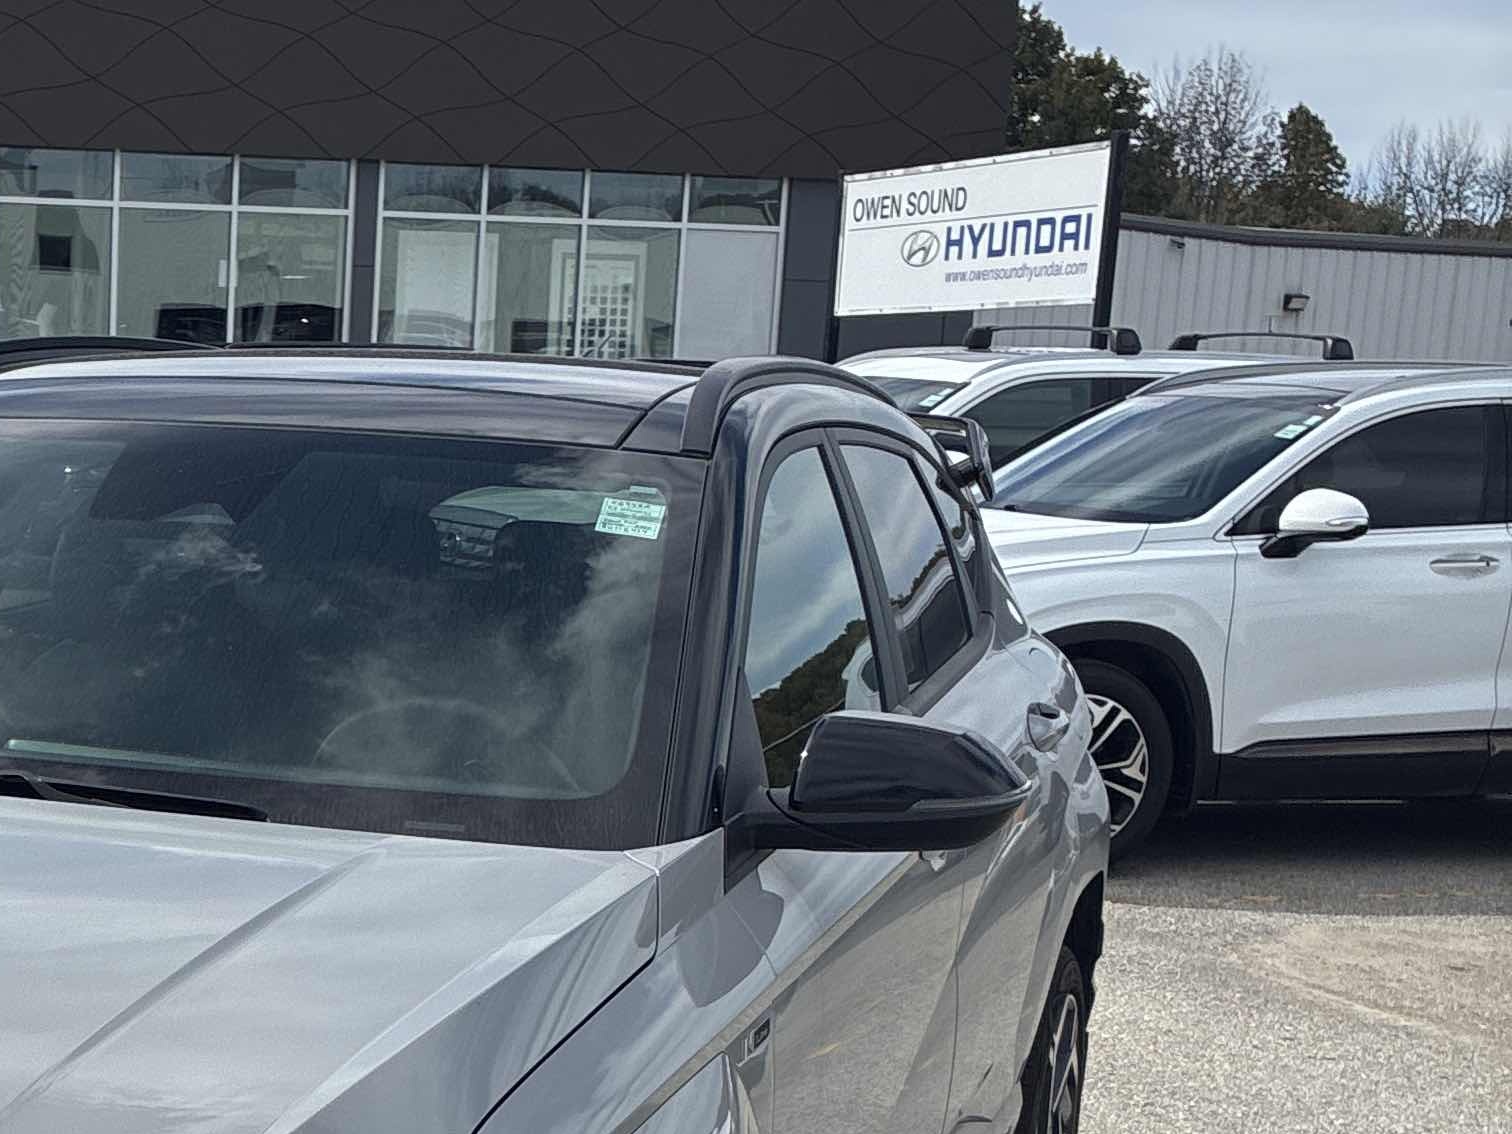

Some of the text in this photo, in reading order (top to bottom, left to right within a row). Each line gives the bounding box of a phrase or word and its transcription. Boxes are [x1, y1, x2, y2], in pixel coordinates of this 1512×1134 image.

[853, 186, 968, 222] OWEN SOUND
[944, 213, 1093, 261] HYUNDAI
[944, 261, 1088, 283] www.owensoundhyundai.com
